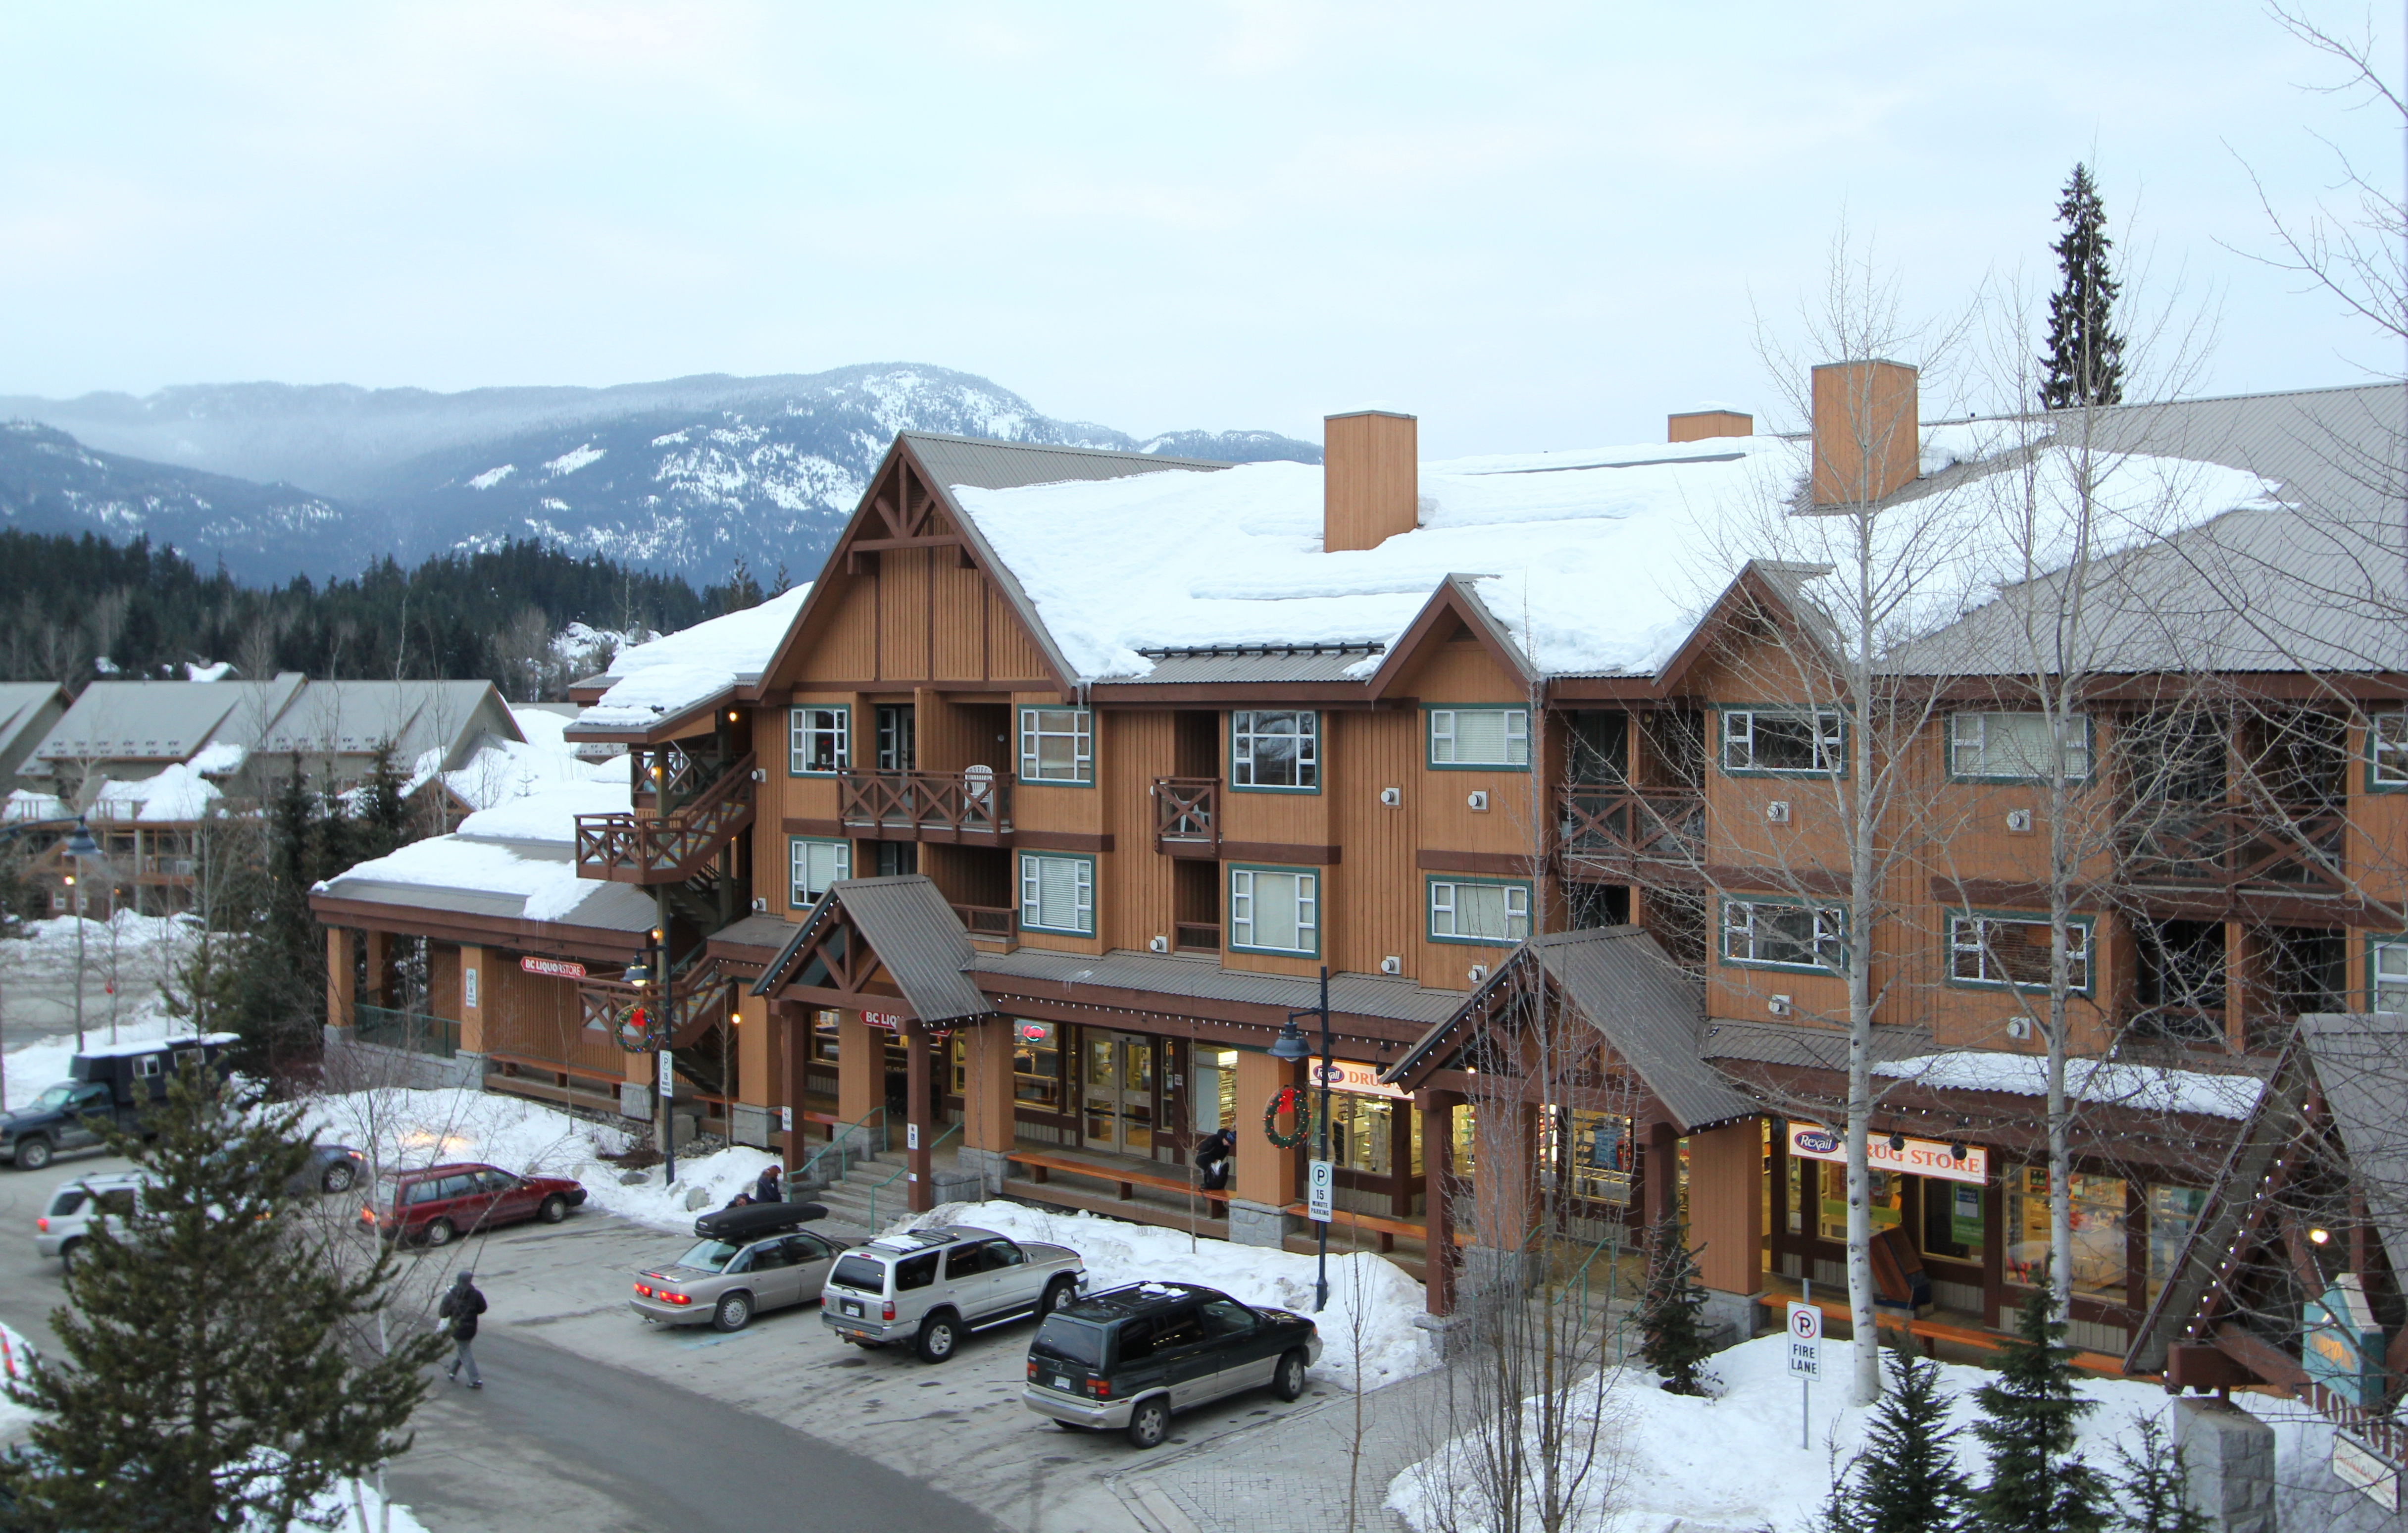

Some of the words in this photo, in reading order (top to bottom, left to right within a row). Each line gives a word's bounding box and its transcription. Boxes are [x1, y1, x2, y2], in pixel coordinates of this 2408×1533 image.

[525, 959, 535, 969] BC
[536, 961, 563, 973] LIQUOR
[562, 965, 581, 976] STORE
[866, 1011, 879, 1023] BC
[881, 1013, 904, 1029] LIQ
[664, 1057, 668, 1067] P
[1317, 1068, 1341, 1081] Rxall
[1349, 1071, 1390, 1088] DRU
[1800, 1134, 1833, 1151] Rexall
[1910, 1150, 1979, 1173] STORE
[1317, 1169, 1325, 1182] P
[1316, 1189, 1324, 1200] 15
[1310, 1207, 1329, 1216] PARKING
[1800, 1316, 1810, 1332] P
[1793, 1343, 1815, 1359] FIRE
[1791, 1358, 1817, 1375] LANE
